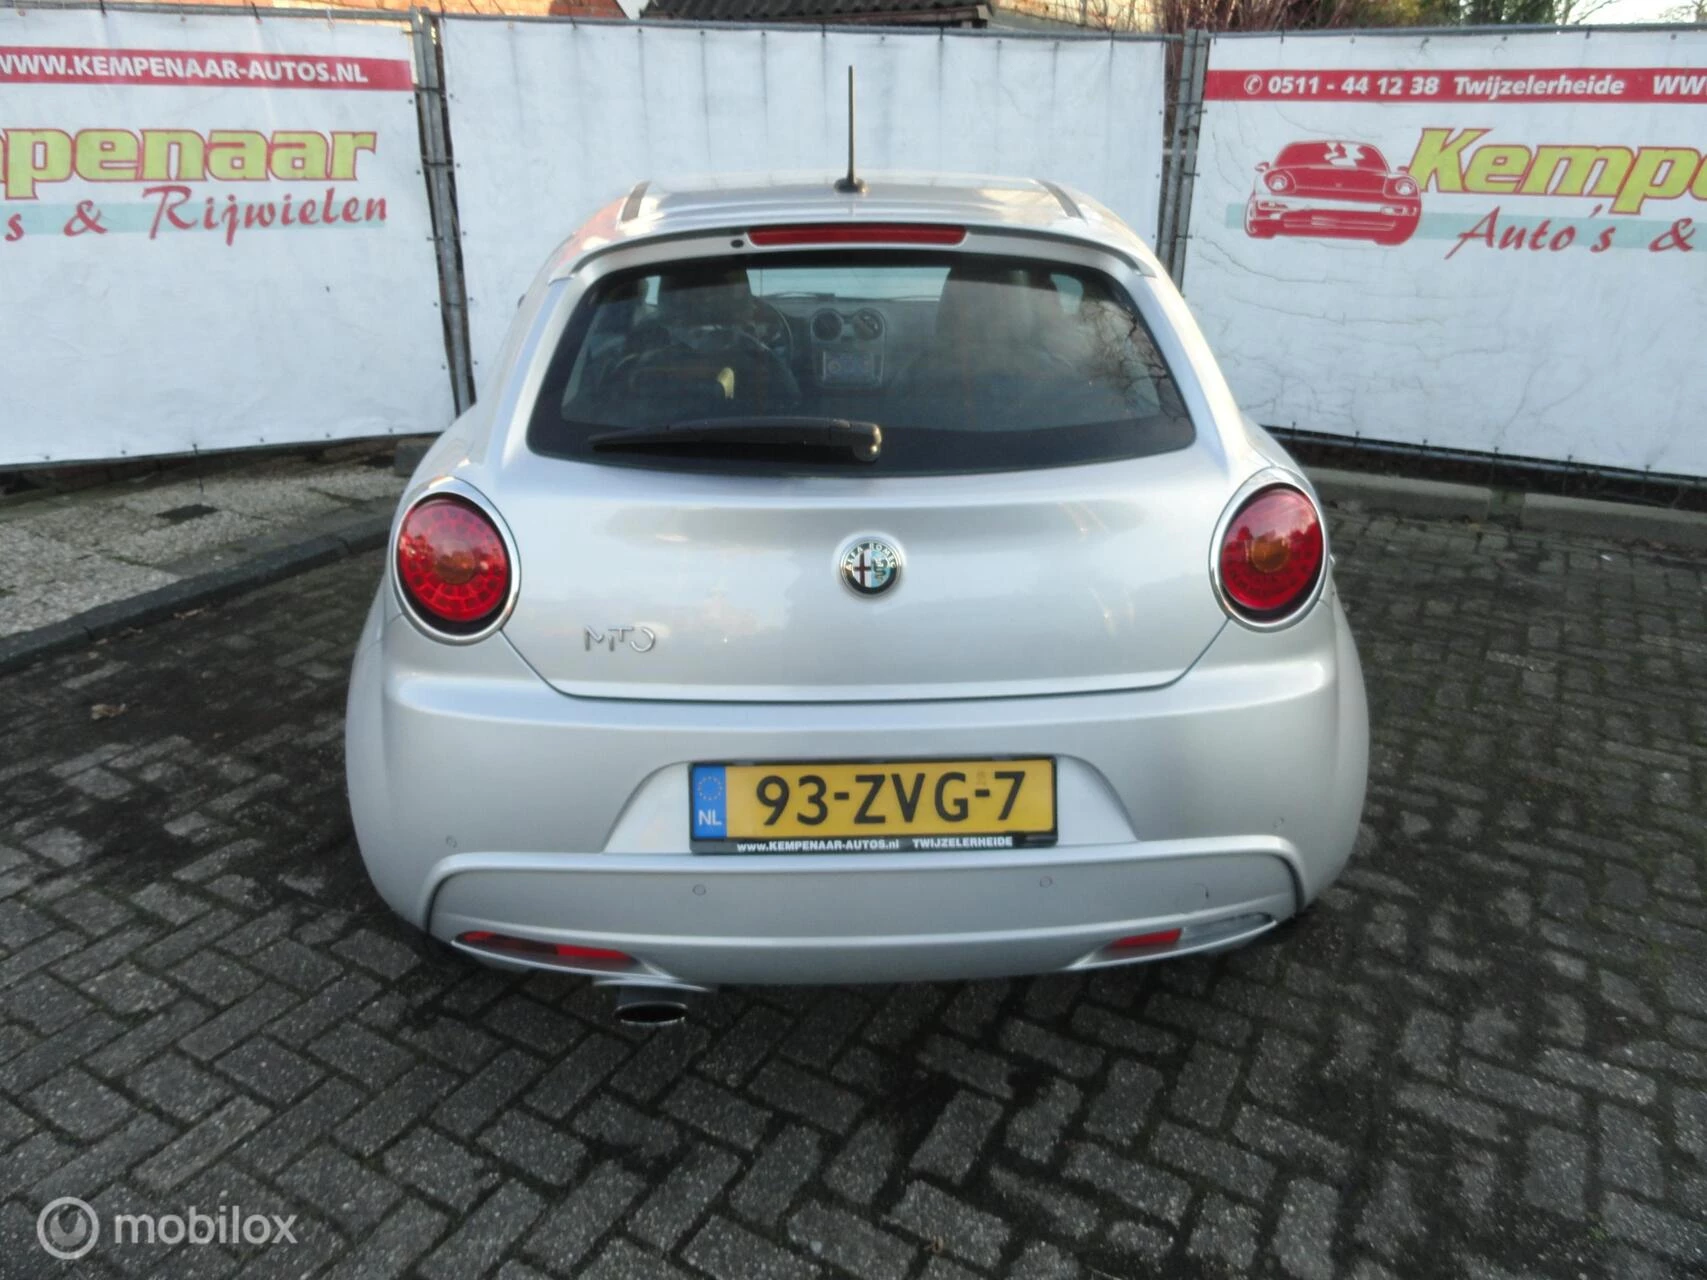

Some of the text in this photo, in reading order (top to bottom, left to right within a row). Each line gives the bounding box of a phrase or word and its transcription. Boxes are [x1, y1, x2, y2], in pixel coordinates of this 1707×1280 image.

[1268, 76, 1319, 94] 0511
[1341, 76, 1369, 94] 44
[1377, 76, 1401, 95] 12
[1409, 77, 1439, 95] 38
[1454, 75, 1625, 100] Twijzelerheide
[0, 128, 377, 200] penaar
[1406, 127, 1707, 215] Kemp
[63, 199, 108, 237] &
[142, 185, 387, 246] Rijwielen
[1444, 204, 1696, 259] Auto's &
[698, 771, 1026, 827] NL 93-ZVG-7
[737, 836, 1013, 852] www.KEMPENAAR-AUTOS.nl TWIJZELERHEIDE
